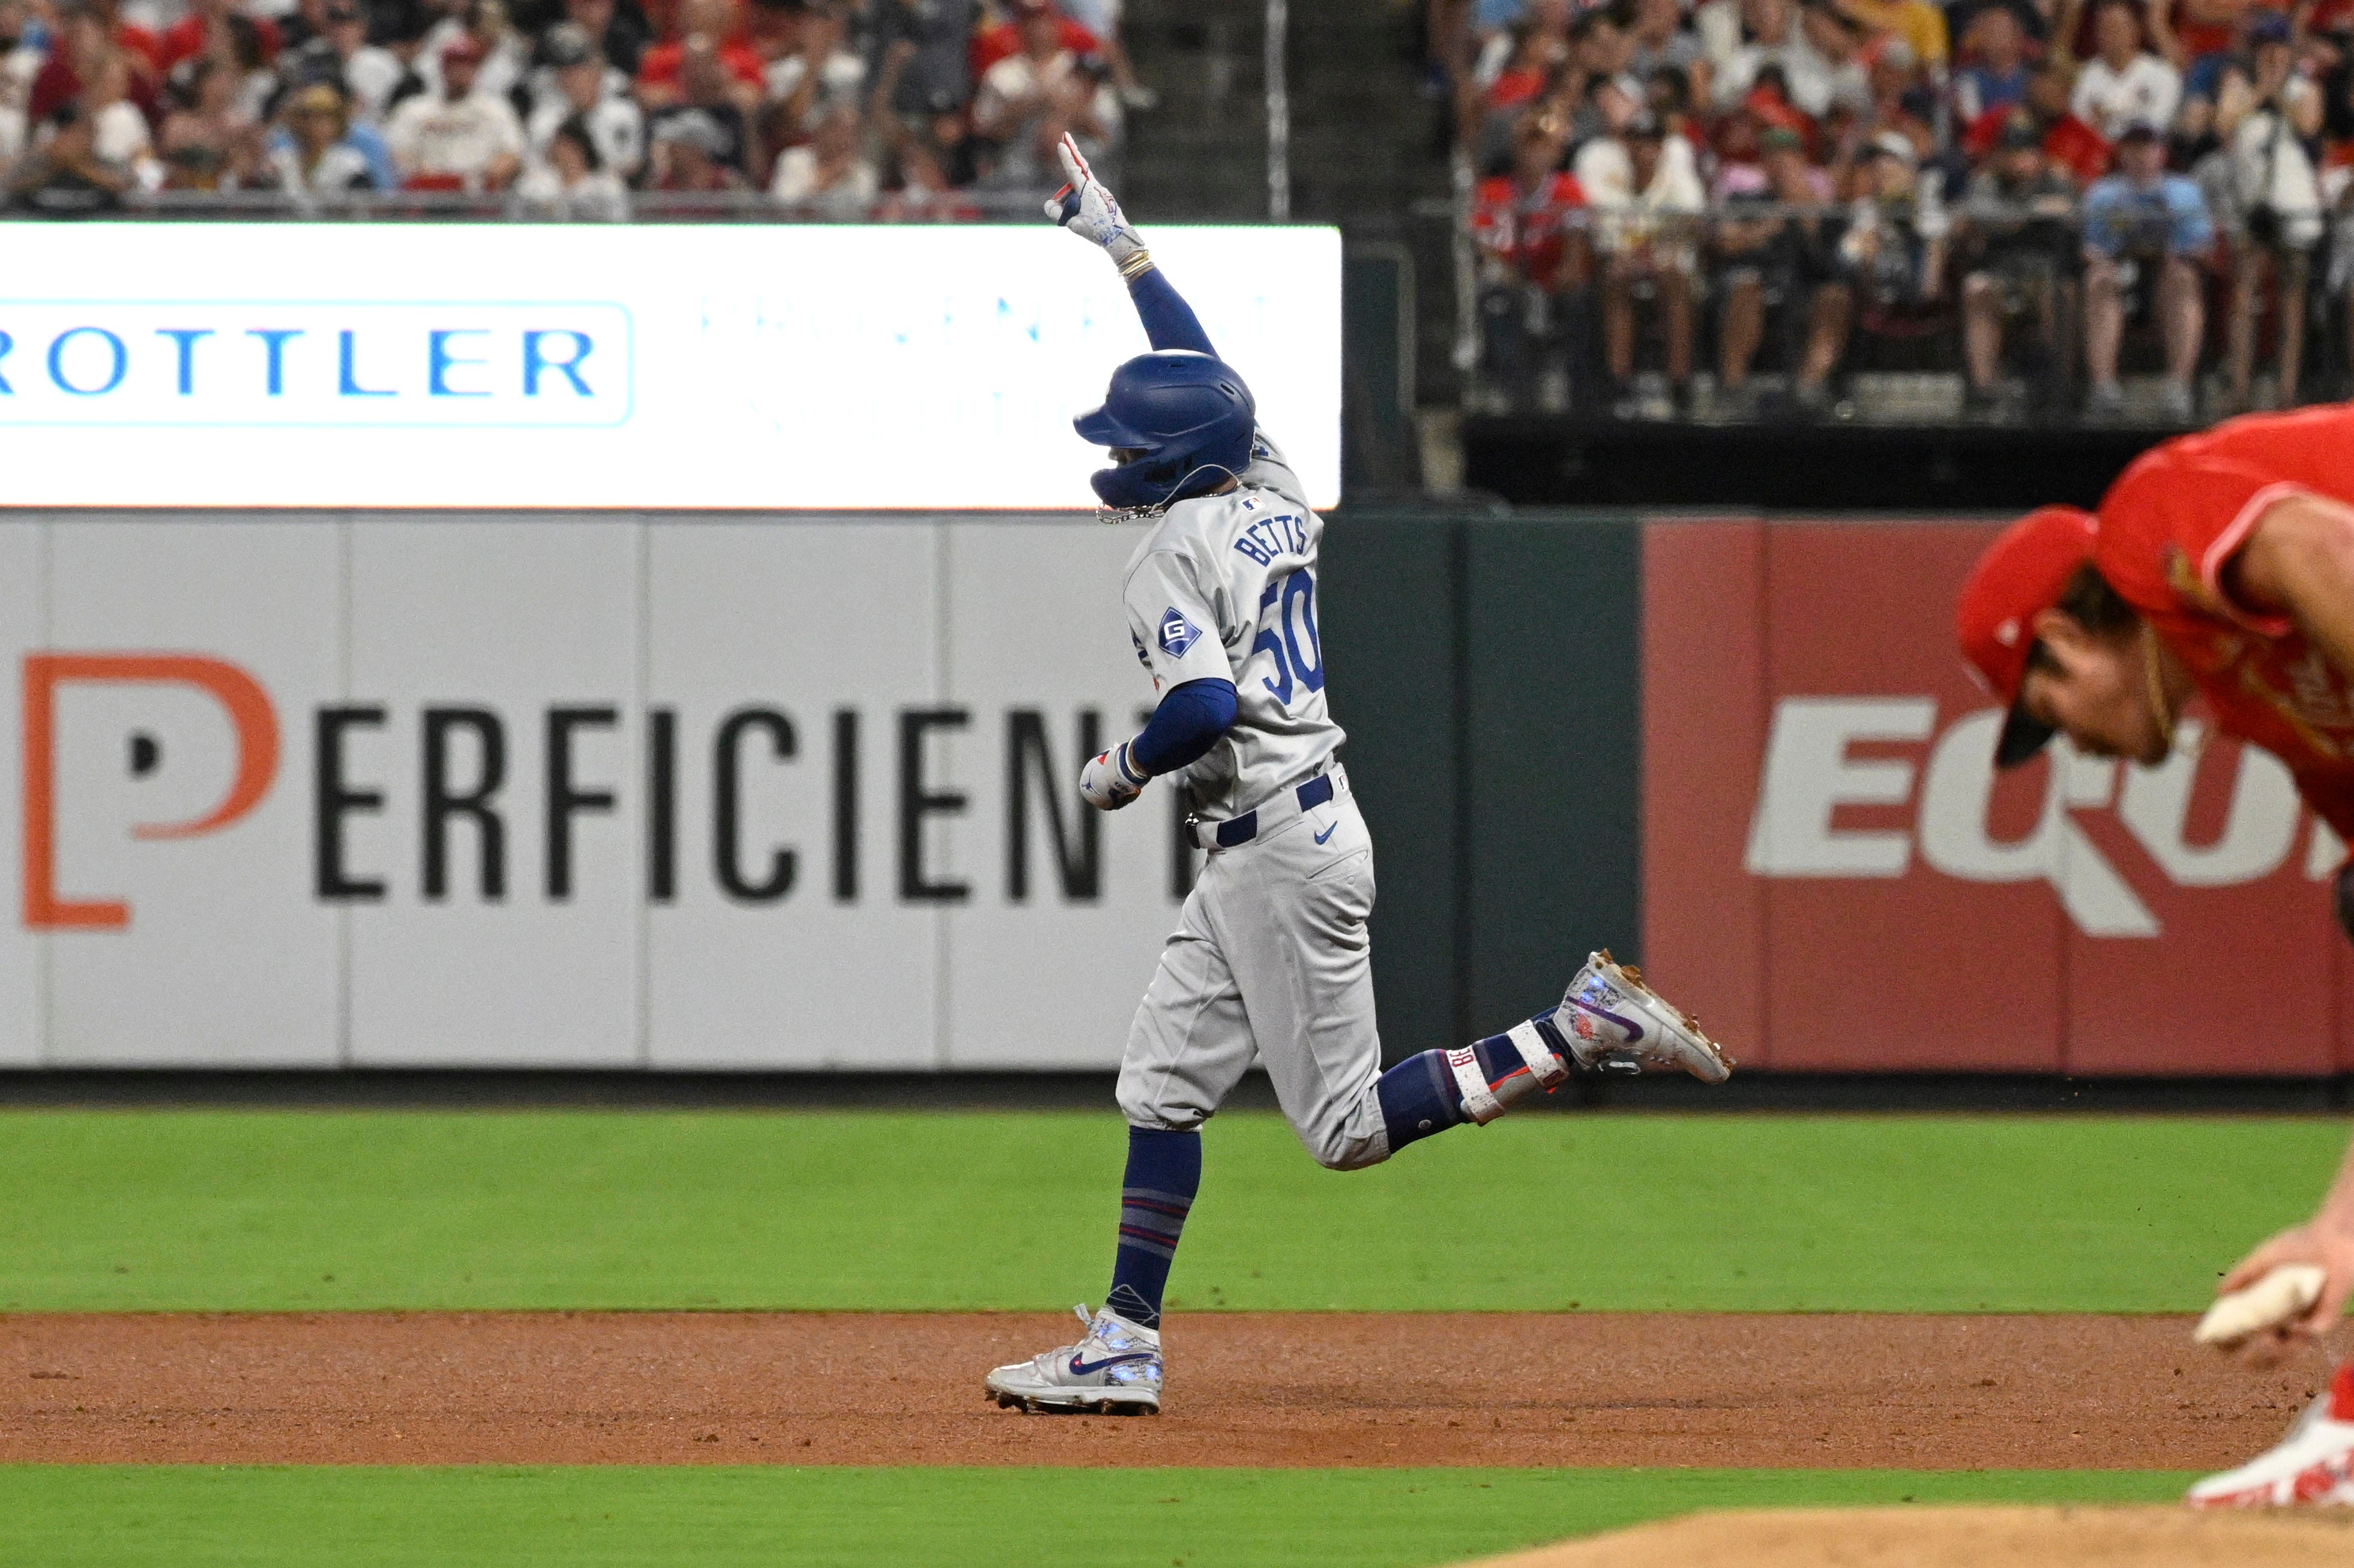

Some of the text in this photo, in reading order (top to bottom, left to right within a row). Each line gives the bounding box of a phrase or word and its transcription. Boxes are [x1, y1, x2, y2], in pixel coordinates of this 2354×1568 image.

[0, 326, 597, 397] OTTLER
[1234, 515, 1308, 566] BETTS
[1164, 619, 1185, 640] G
[1252, 568, 1323, 705] 50
[1742, 695, 2349, 938] EQU
